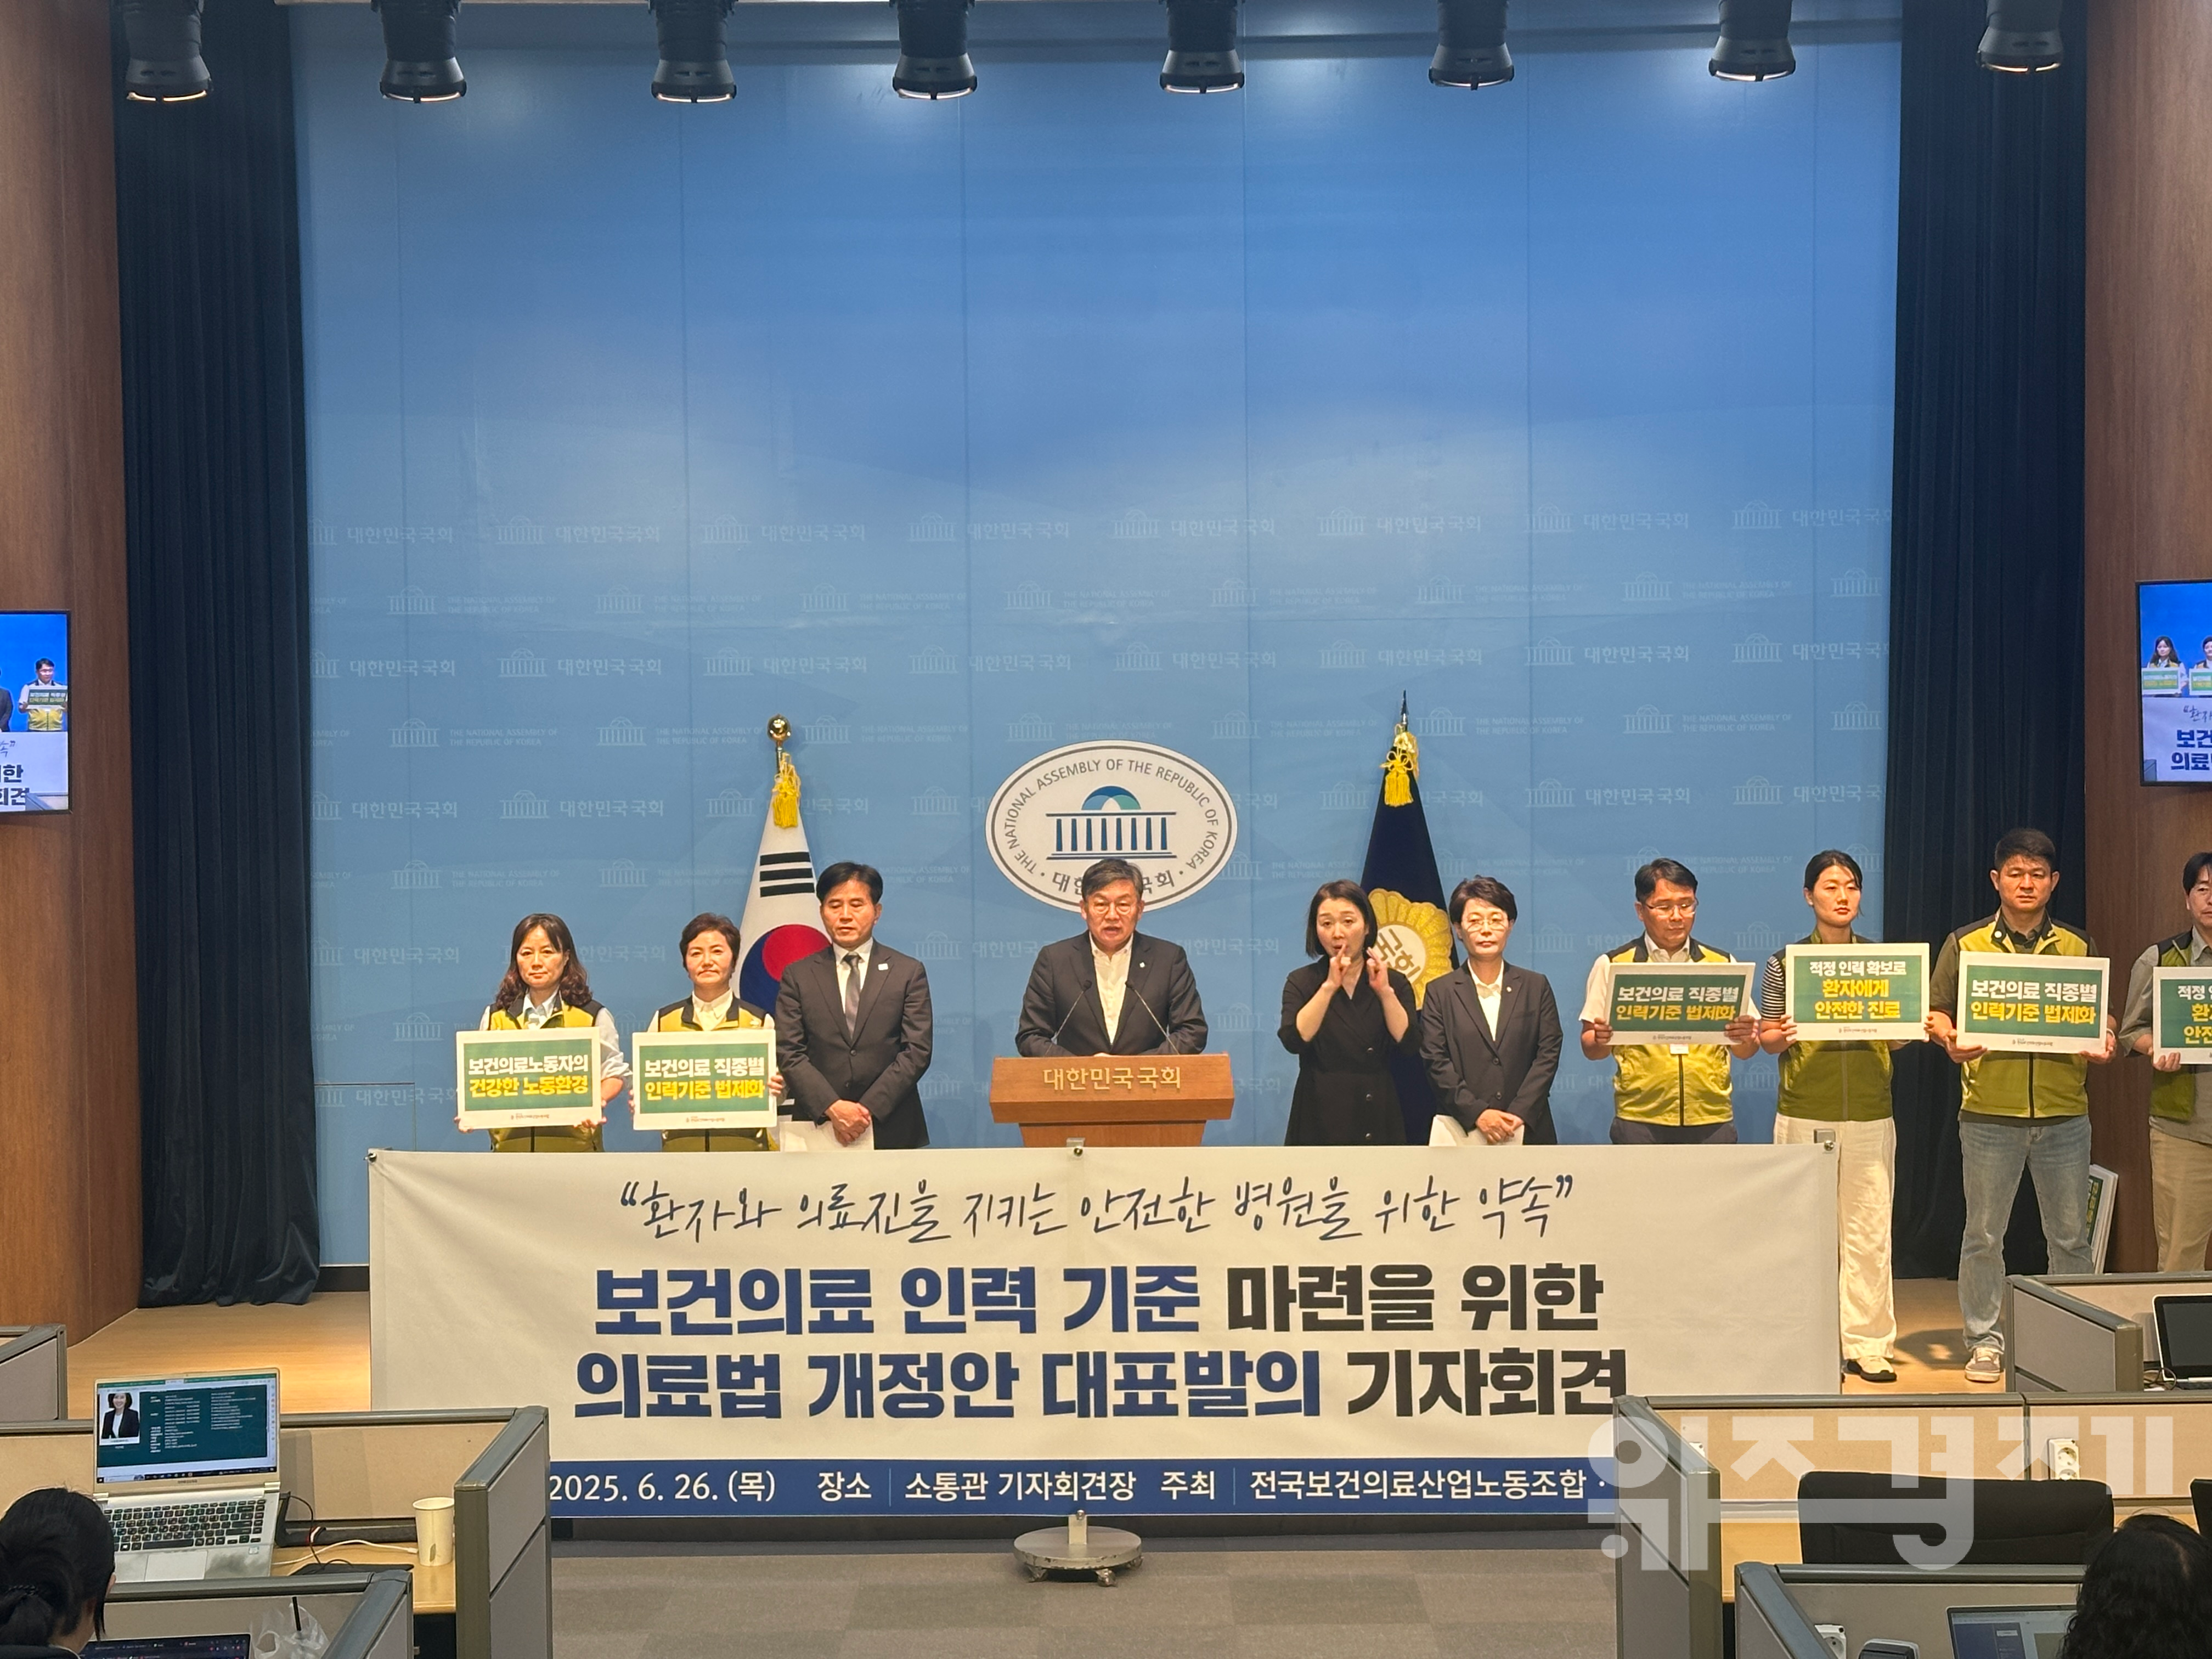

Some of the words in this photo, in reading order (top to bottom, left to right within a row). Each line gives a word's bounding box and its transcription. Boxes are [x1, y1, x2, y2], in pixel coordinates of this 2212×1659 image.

[1106, 759, 1123, 771] OF
[1128, 759, 1153, 775] THE
[2171, 752, 2212, 770] 의료
[0, 765, 24, 783] 한
[1036, 759, 1101, 791] ASSEMBLY
[1155, 766, 1210, 808] REPUBLIC
[1005, 787, 1036, 850] NATIONAL
[1205, 809, 1218, 826] OF
[1186, 831, 1218, 870] KOREA
[1014, 850, 1037, 874] THE
[1809, 961, 1836, 977] 적정
[1838, 961, 1865, 977] 인력
[1866, 961, 1906, 976] 확보로
[1617, 986, 1684, 1002] 보건의료
[1689, 986, 1739, 1003] 직종별
[1822, 978, 1889, 998] 환자에게
[1971, 979, 2040, 1000] 보건의료
[2044, 982, 2097, 1003] 직종별
[2177, 985, 2205, 1001] 적정
[1616, 1005, 1682, 1020] 인력기준
[1686, 1005, 1736, 1021] 법제화
[1814, 1000, 1865, 1020] 안전한
[1867, 1000, 1901, 1019] 진료
[1970, 1001, 2040, 1023] 인력기준
[2044, 1005, 2096, 1024] 법제화
[2191, 1003, 2212, 1022] 환
[469, 1054, 588, 1075] 보건의료노동자의
[644, 1059, 711, 1078] 보건의료
[714, 1057, 765, 1077] 직종별
[469, 1077, 520, 1097] 건강한
[522, 1075, 588, 1095] 노동환경
[1043, 1066, 1181, 1091] 대한민국국회
[645, 1080, 712, 1101] 인력기준
[715, 1079, 765, 1099] 법제화
[797, 1179, 951, 1243] 의료진을
[963, 1182, 1068, 1237] 지키는
[1081, 1176, 1215, 1233] 안전한
[1235, 1176, 1362, 1242] 병원을
[1375, 1175, 1460, 1234] 위한
[595, 1268, 874, 1335] 보건의료
[900, 1266, 1036, 1335] 인력
[1063, 1265, 1200, 1332] 기준
[1227, 1263, 1435, 1331] 마련을
[1460, 1263, 1604, 1331] 위한
[575, 1353, 781, 1419] 의료법
[808, 1351, 1019, 1419] 개정안
[1042, 1350, 1320, 1418] 대표발의
[1347, 1347, 1626, 1416] 기자회견
[549, 1475, 627, 1502] 2025.
[639, 1472, 663, 1500] 6.
[817, 1471, 872, 1500] 장소
[905, 1470, 988, 1501] 소통관
[998, 1470, 1136, 1501] 기자회견장
[1160, 1470, 1216, 1500] 주최
[1250, 1469, 1586, 1500] 전국보건의료산업노동조합
